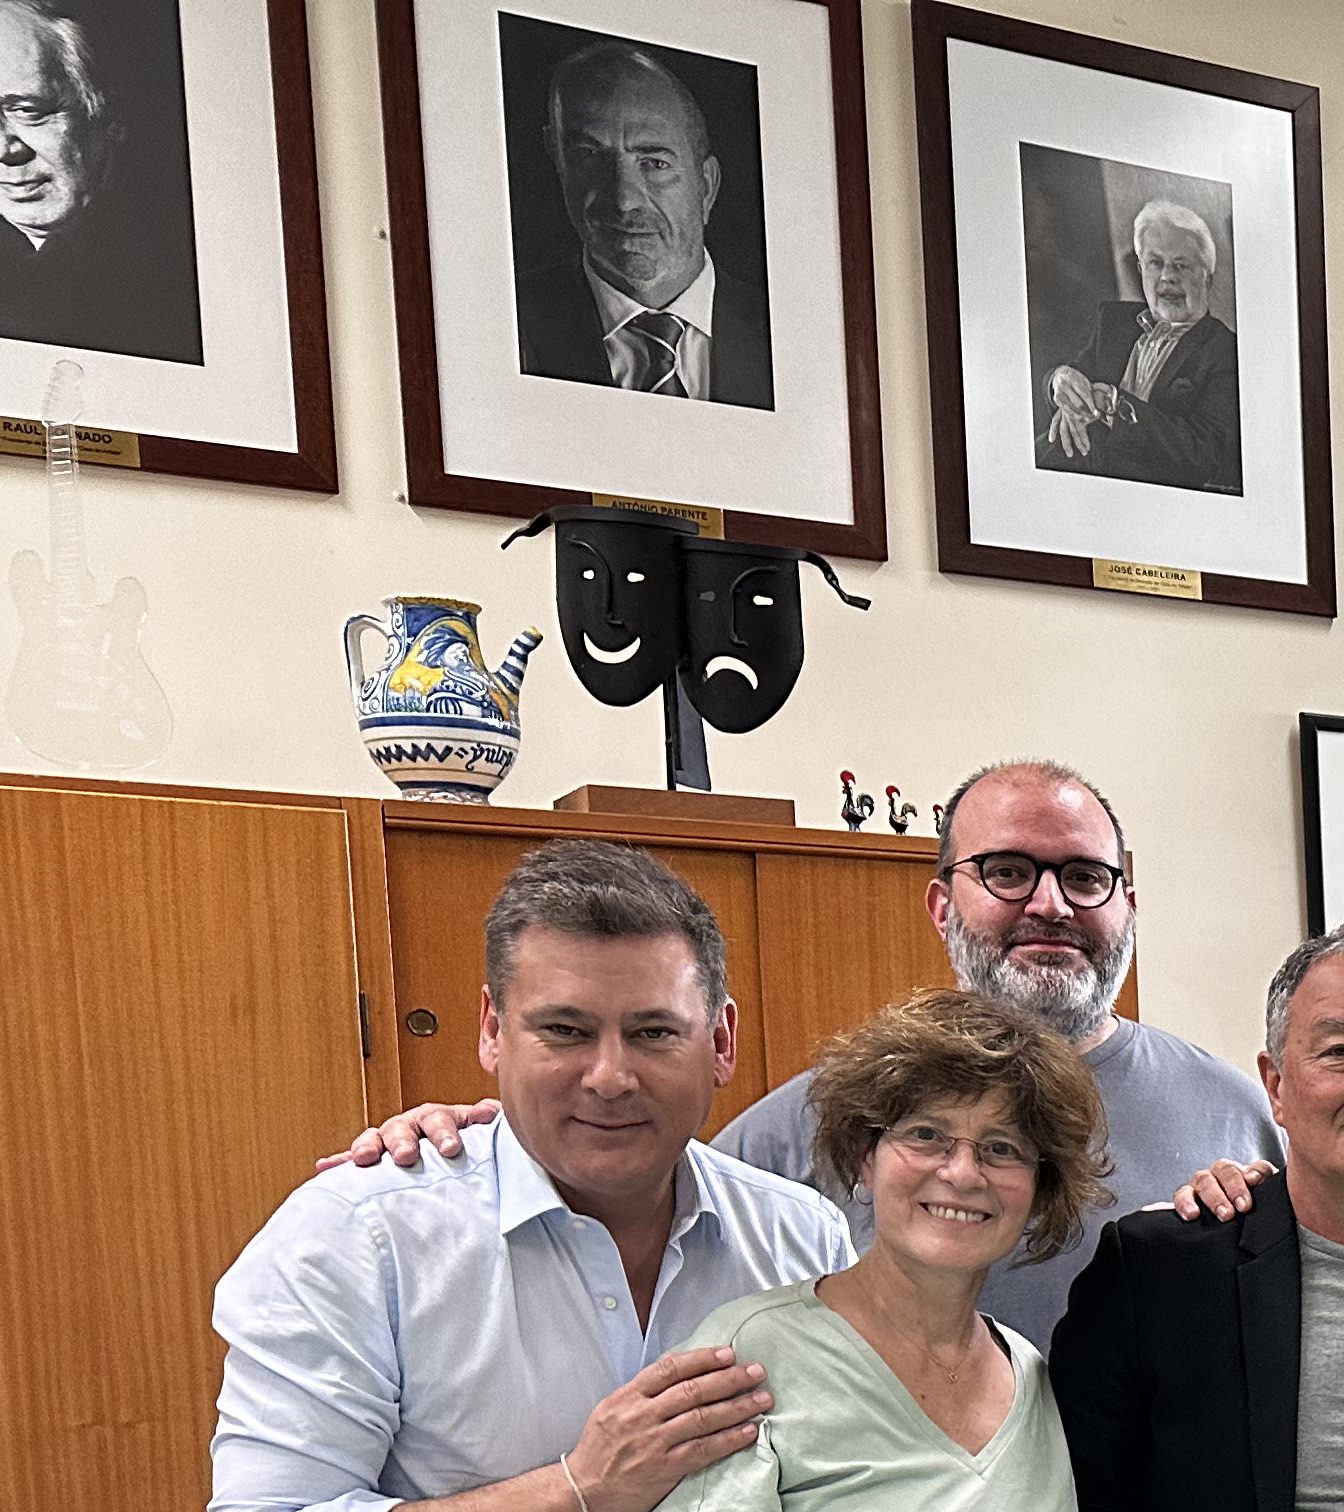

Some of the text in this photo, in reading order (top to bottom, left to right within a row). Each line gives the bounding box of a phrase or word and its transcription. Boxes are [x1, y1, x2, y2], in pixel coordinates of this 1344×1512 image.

[2, 421, 42, 436] RAUL
[661, 507, 708, 521] PARENTE
[1109, 565, 1187, 581] JOSÉ CABELEIRA
